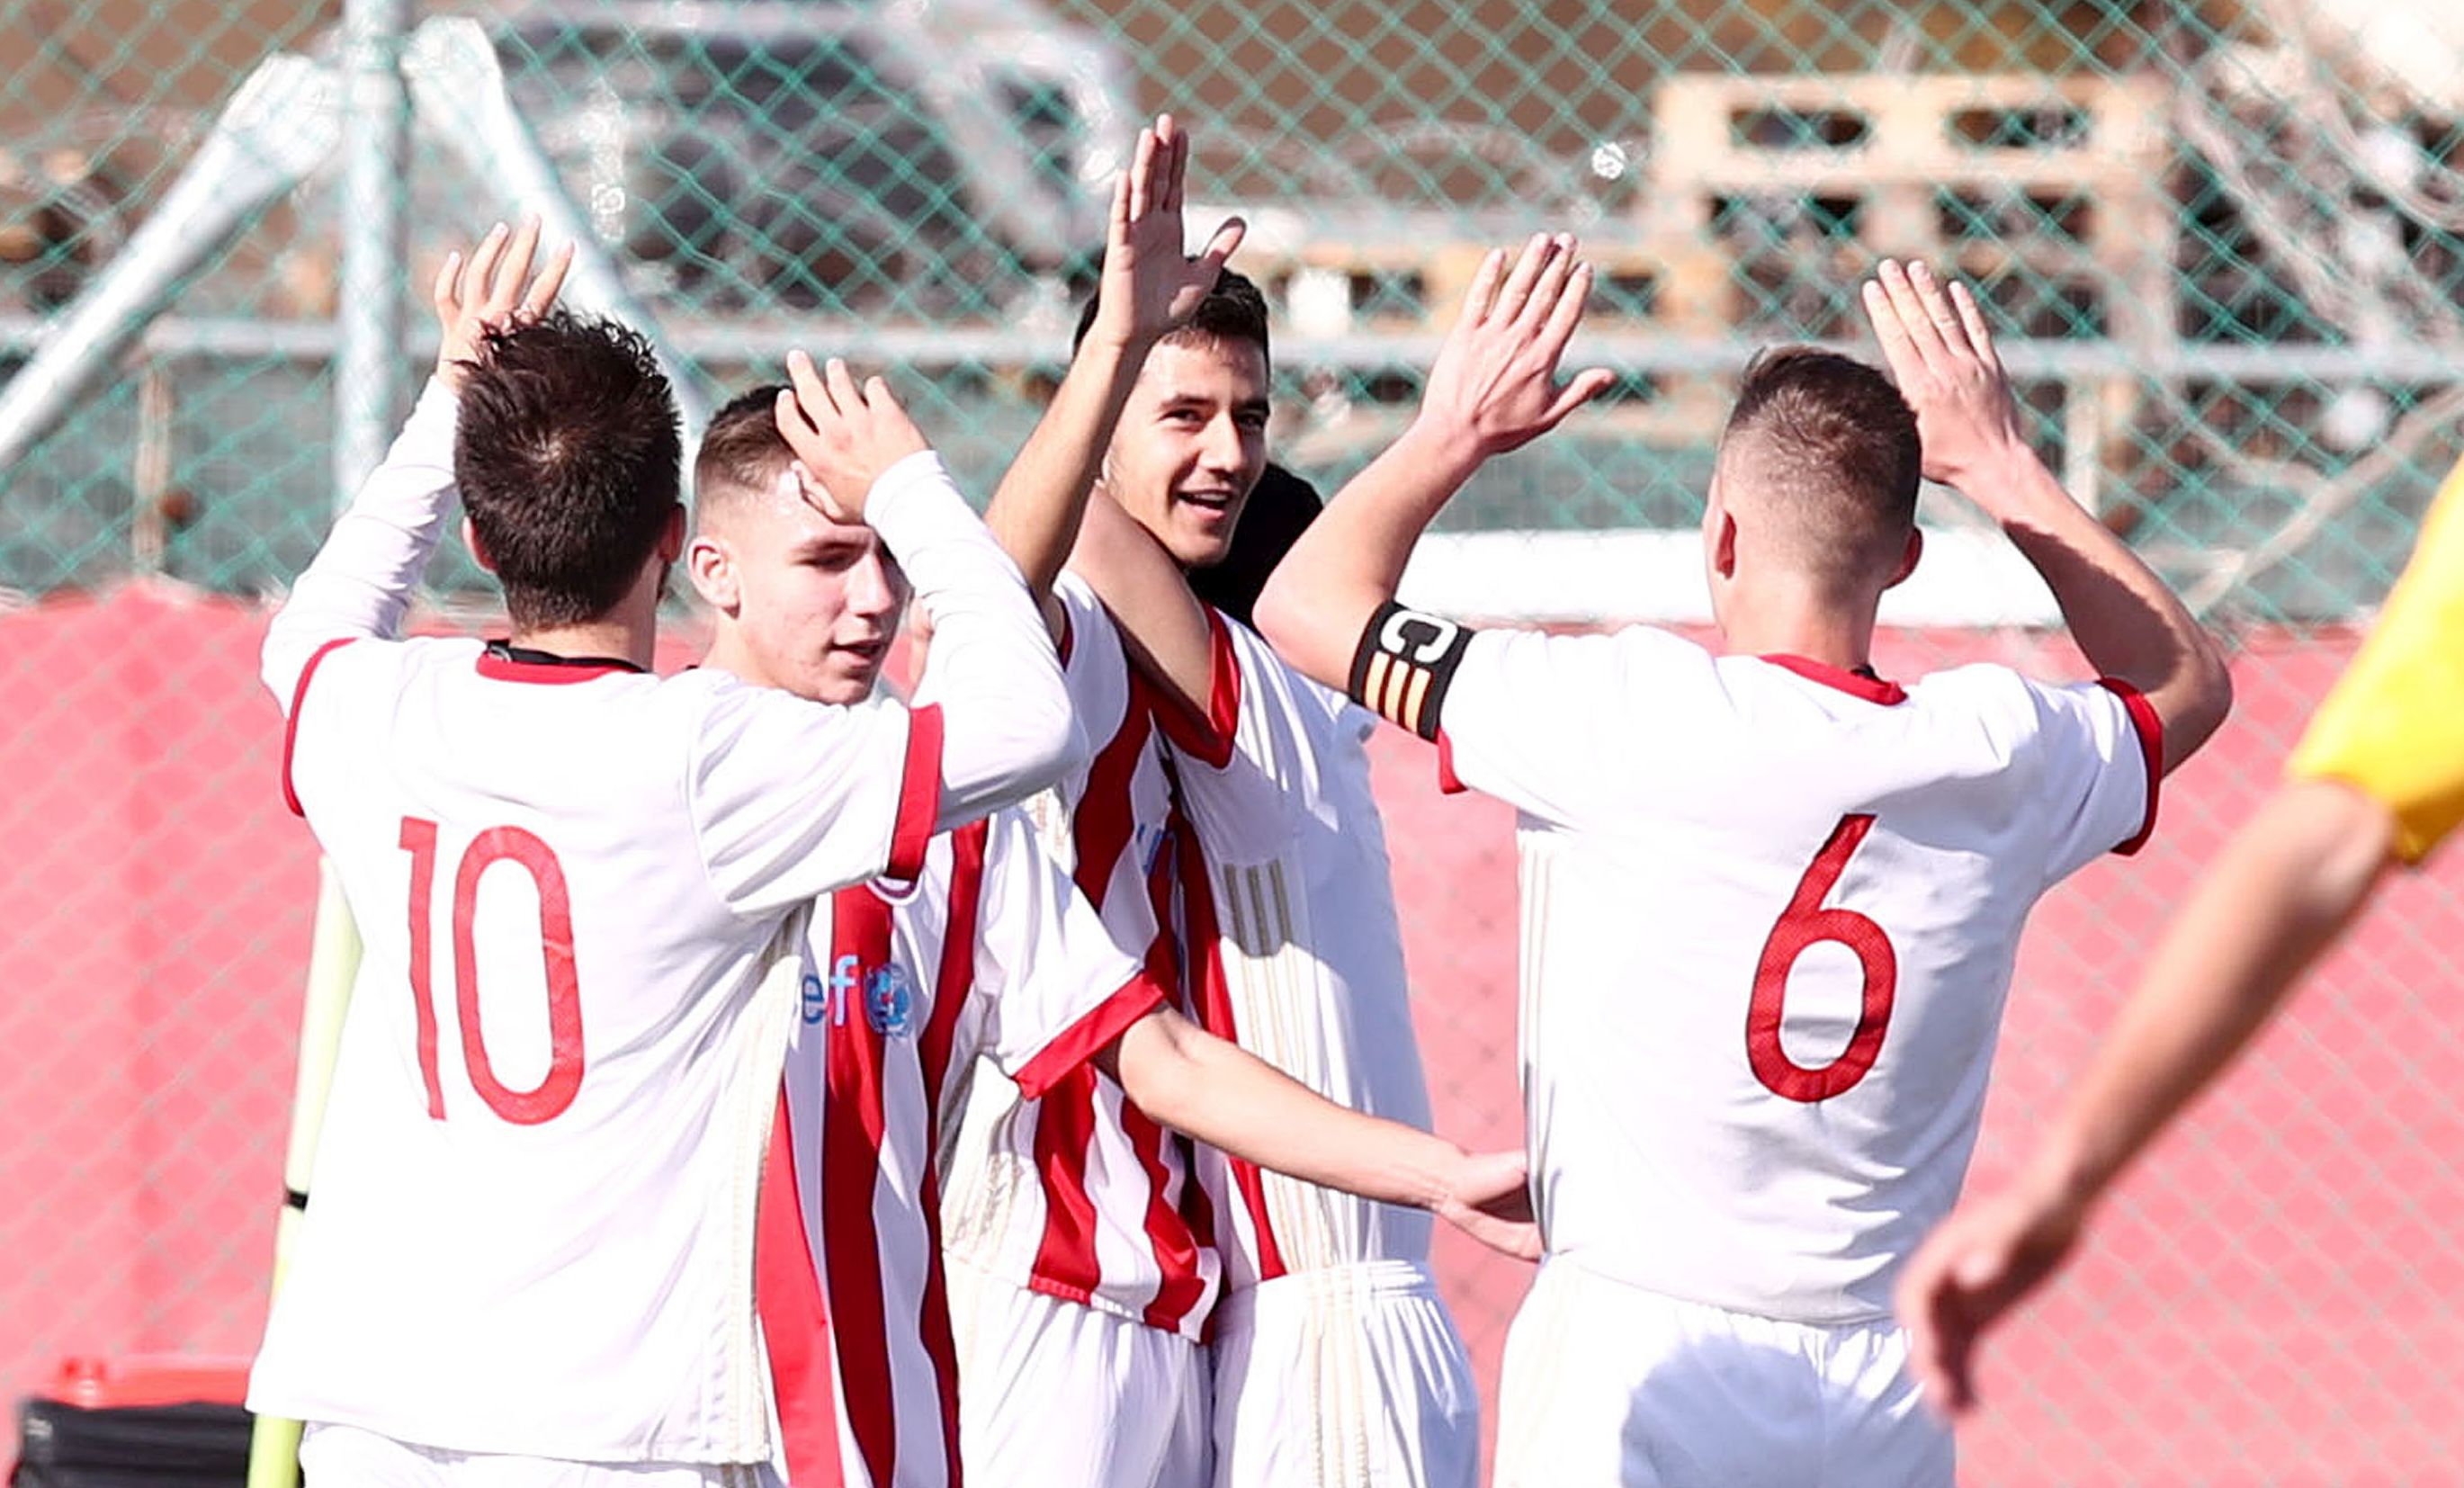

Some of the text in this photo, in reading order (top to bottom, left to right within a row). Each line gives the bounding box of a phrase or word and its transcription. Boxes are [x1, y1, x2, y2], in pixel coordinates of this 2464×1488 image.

[1381, 610, 1458, 663] C
[399, 815, 585, 1126] 10
[802, 955, 859, 1026] ef
[1745, 813, 1896, 1103] 6
